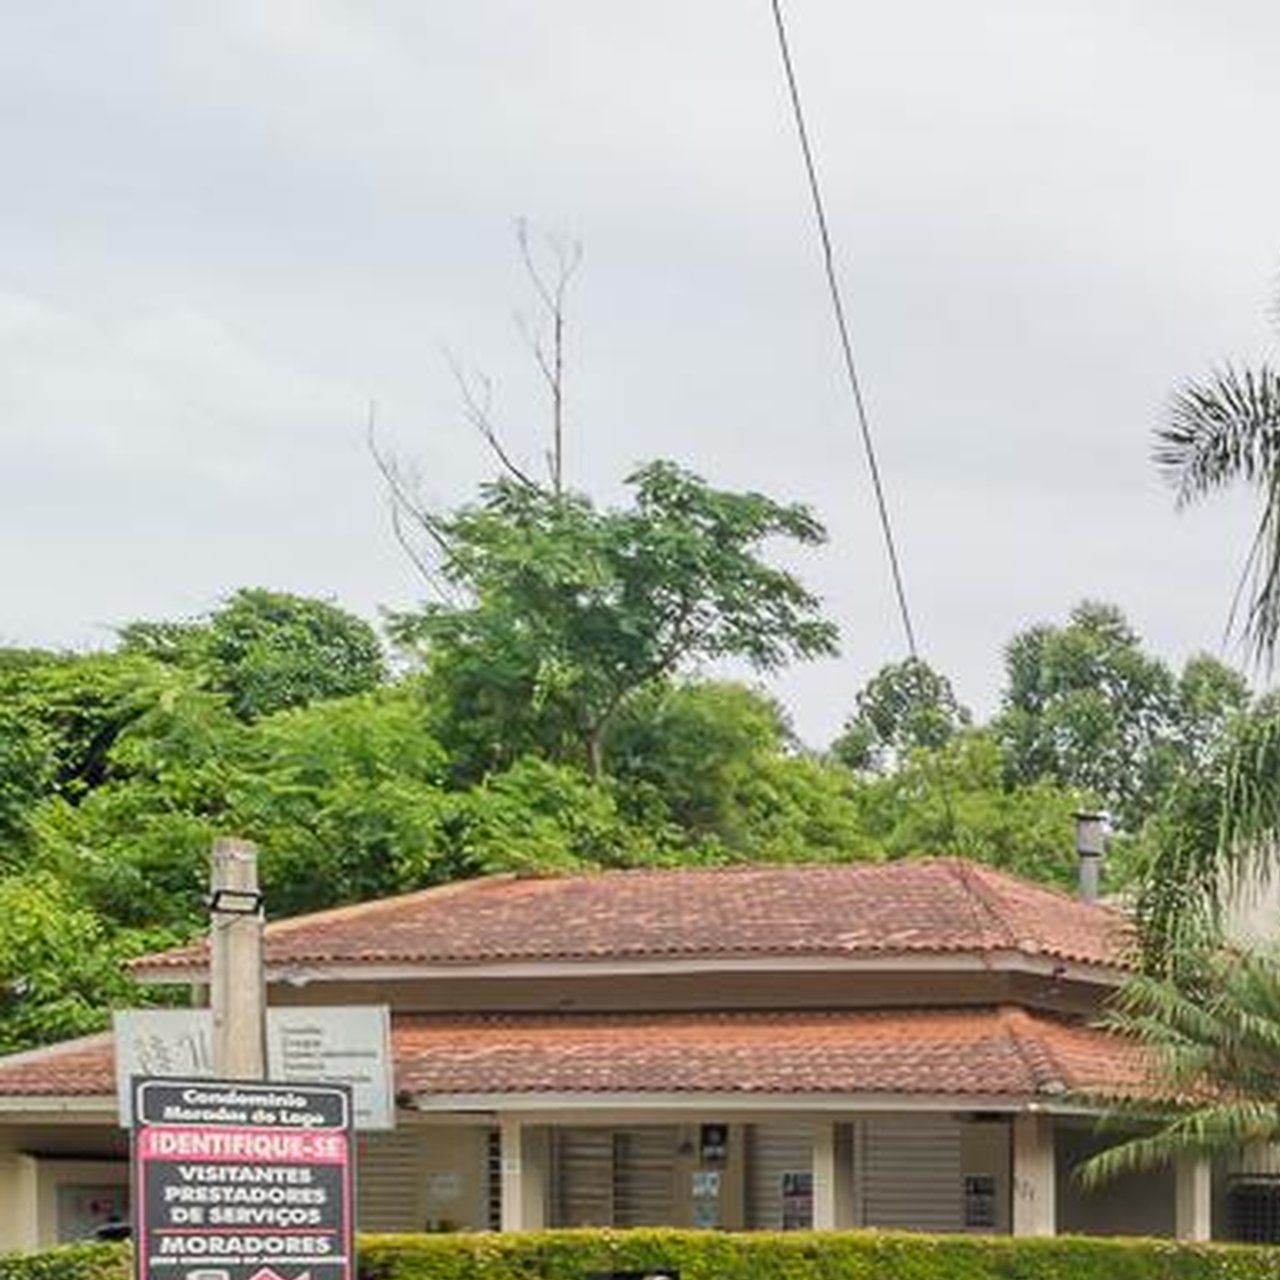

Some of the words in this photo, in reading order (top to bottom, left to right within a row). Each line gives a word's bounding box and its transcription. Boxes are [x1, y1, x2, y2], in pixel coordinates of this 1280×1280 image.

[279, 1111, 326, 1127] Lago
[151, 1133, 343, 1159] IDENTIFIQUE-SE
[180, 1165, 312, 1183] VISITANTES
[165, 1186, 327, 1204] PRESTADORES
[170, 1207, 201, 1223] DE
[209, 1207, 321, 1226] SERVIÇOS
[160, 1235, 332, 1254] MORADORES
